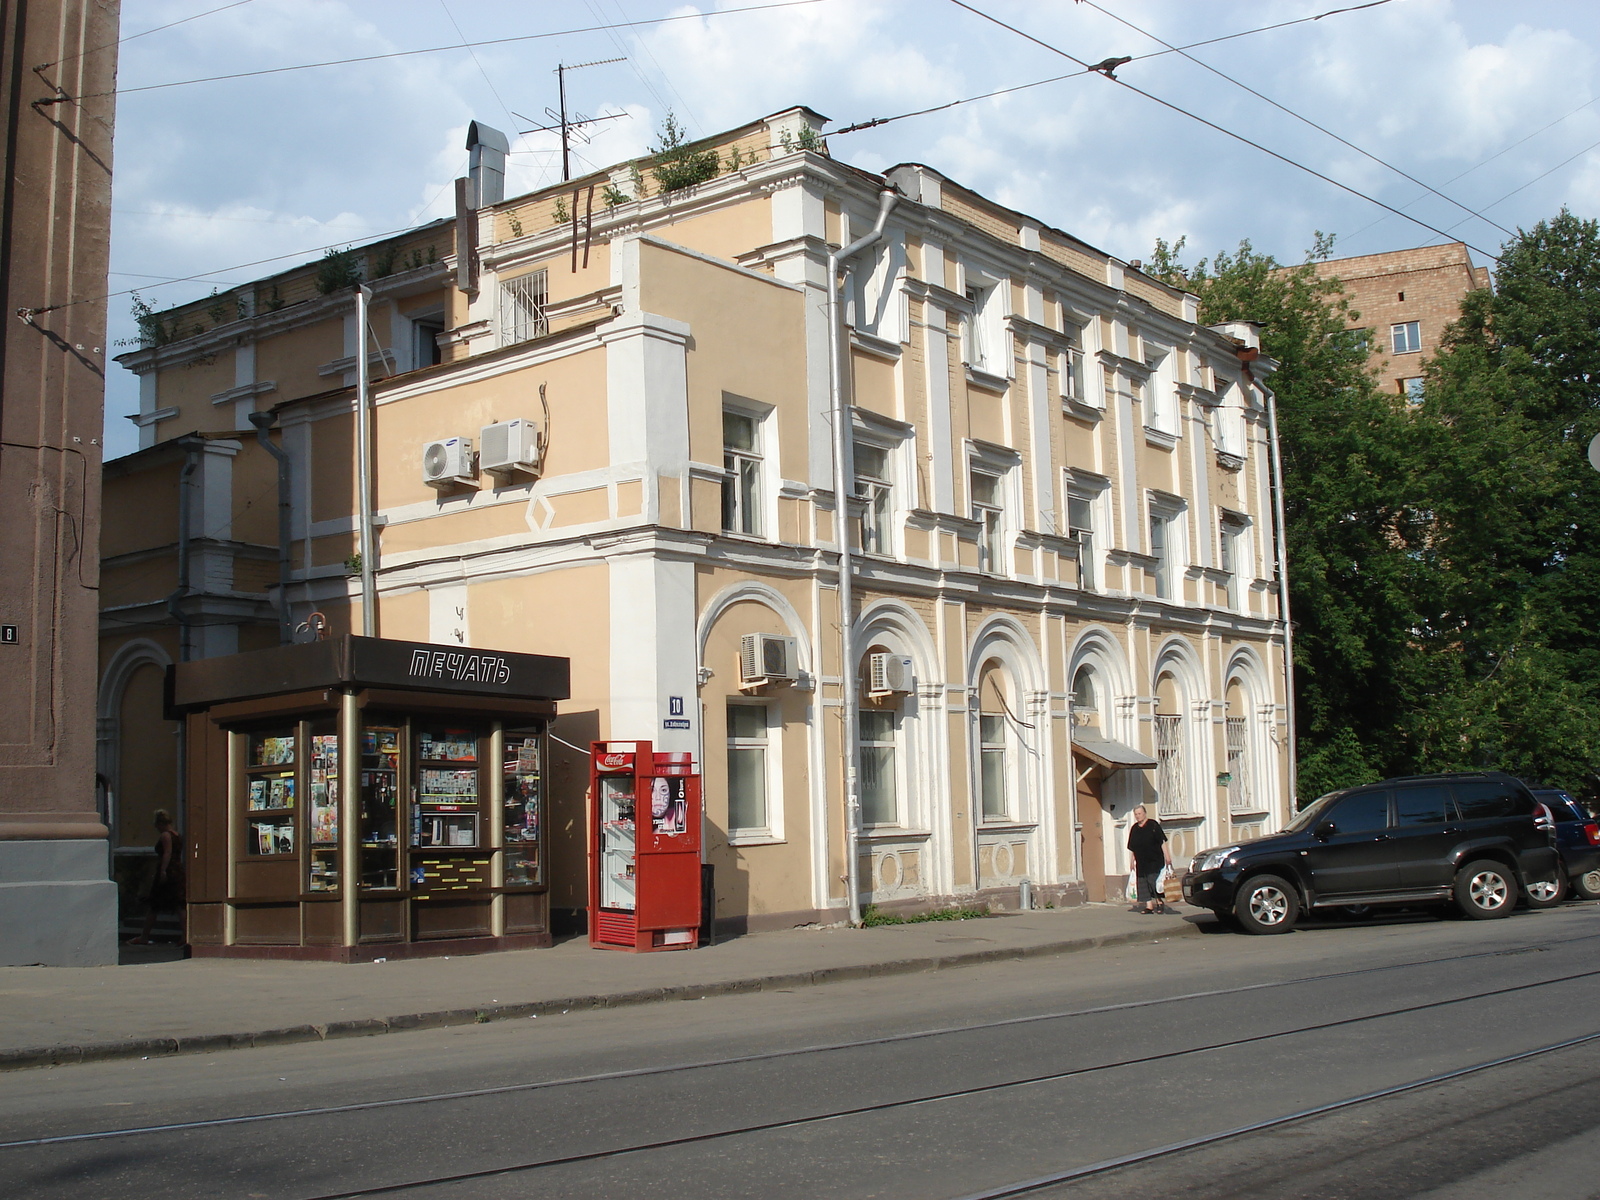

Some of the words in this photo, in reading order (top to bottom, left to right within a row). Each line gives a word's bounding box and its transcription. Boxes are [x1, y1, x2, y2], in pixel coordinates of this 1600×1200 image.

[6, 628, 12, 640] 8
[409, 649, 510, 684] ПЕЧАТЬ
[671, 699, 681, 713] 10
